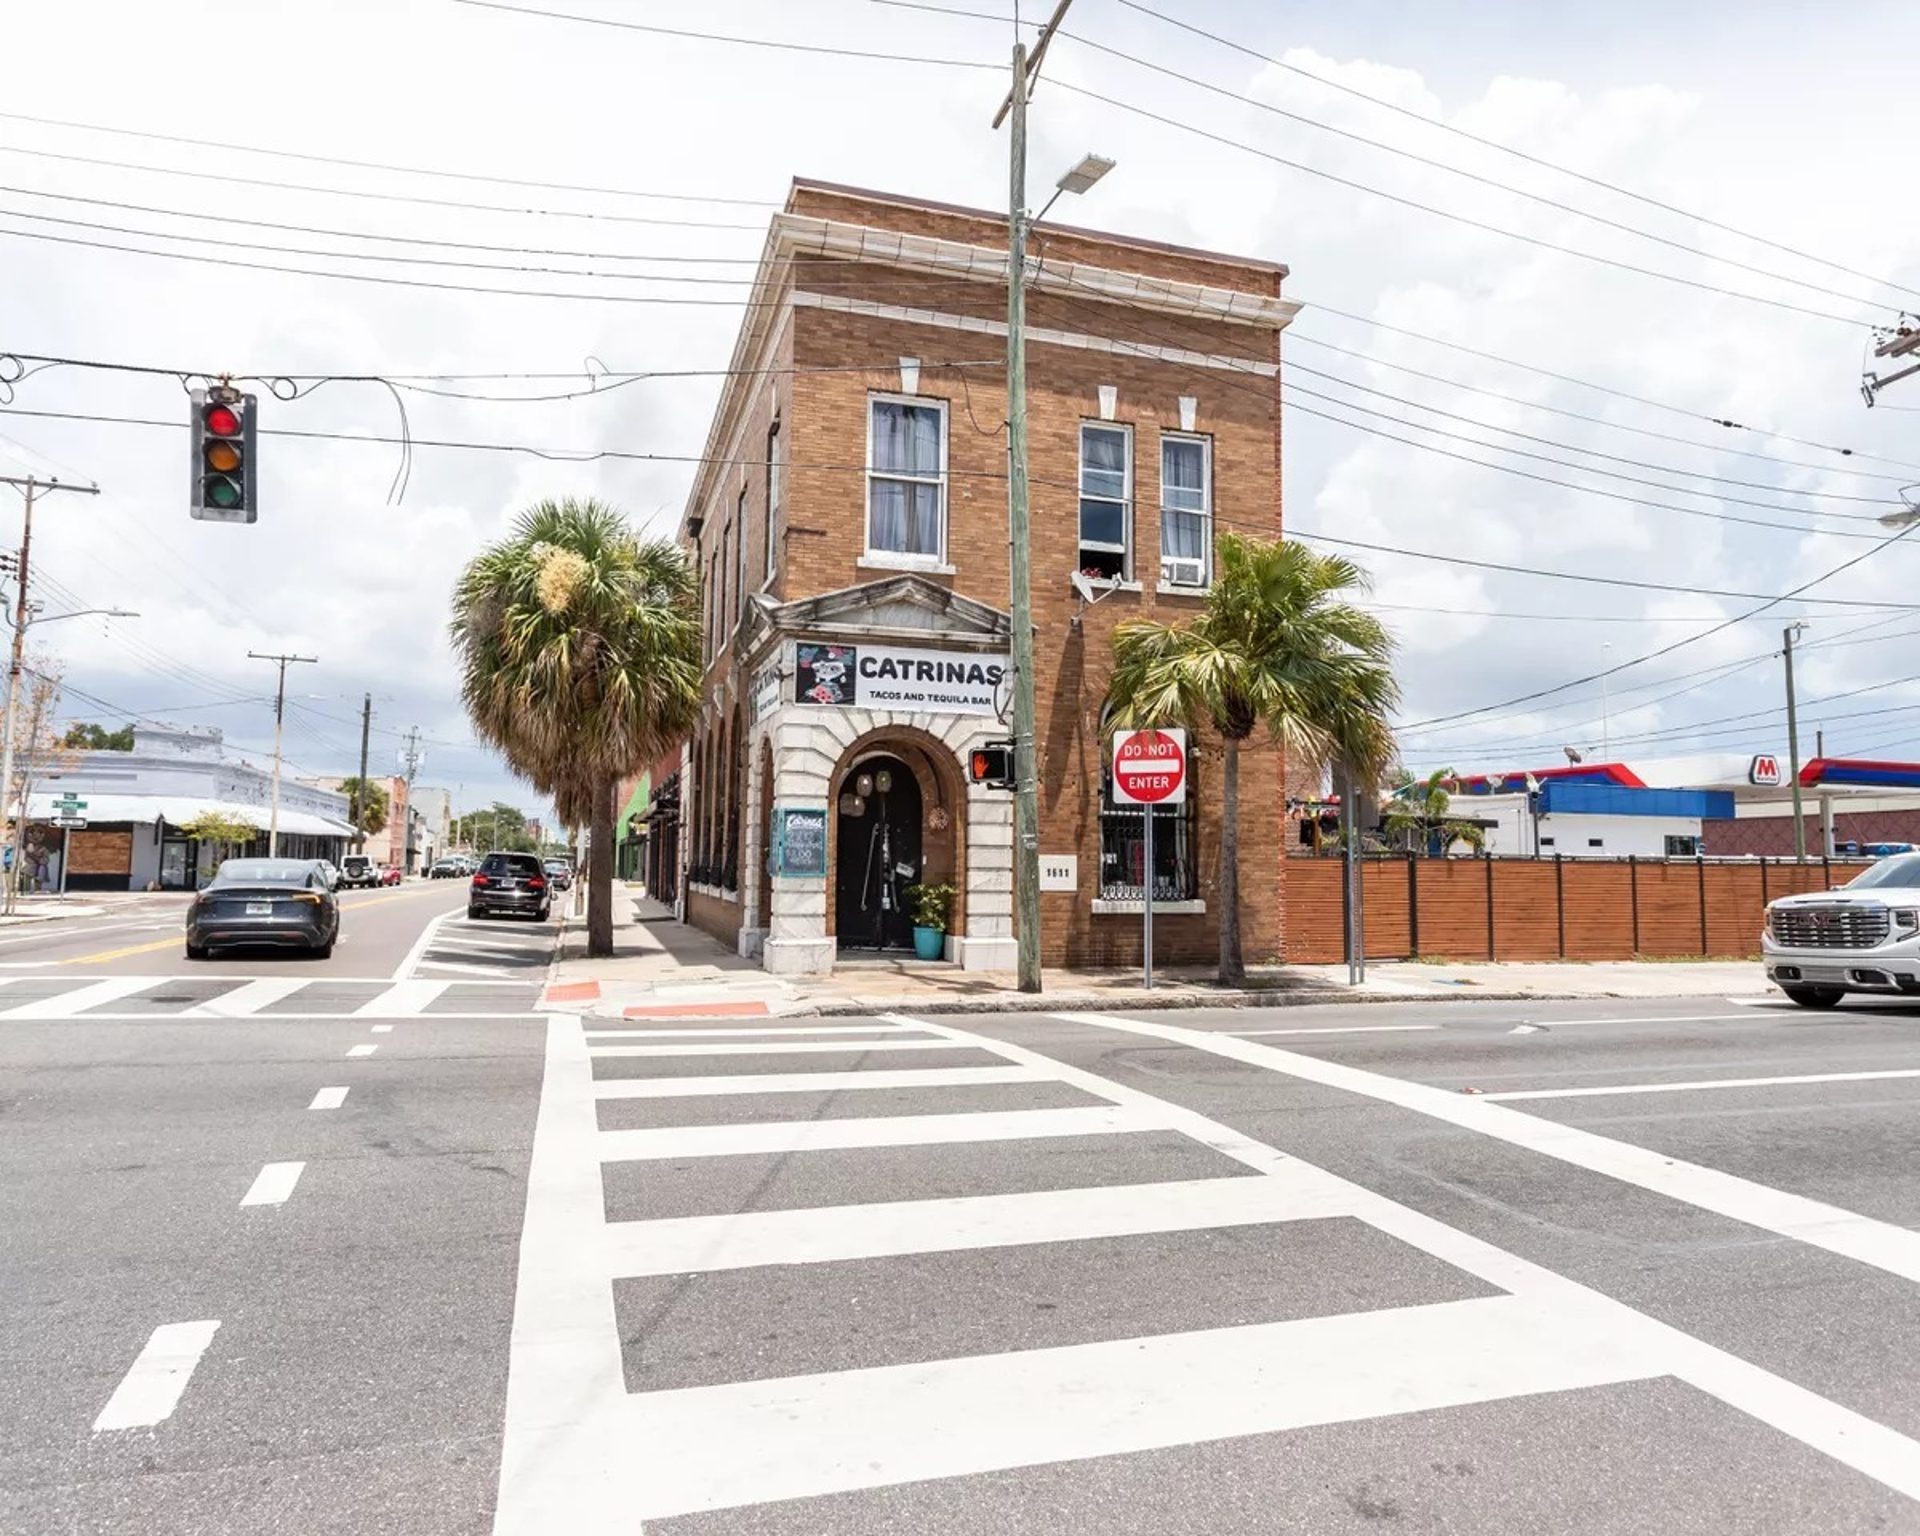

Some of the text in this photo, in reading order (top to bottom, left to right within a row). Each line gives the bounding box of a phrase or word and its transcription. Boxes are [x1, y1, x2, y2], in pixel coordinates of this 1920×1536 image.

[859, 656, 1003, 686] CATRINAS
[869, 690, 991, 705] TACOS AND TEQUILA BAR
[1124, 743, 1175, 757] DO NOT
[1757, 759, 1776, 776] M
[1128, 775, 1169, 789] ENTER
